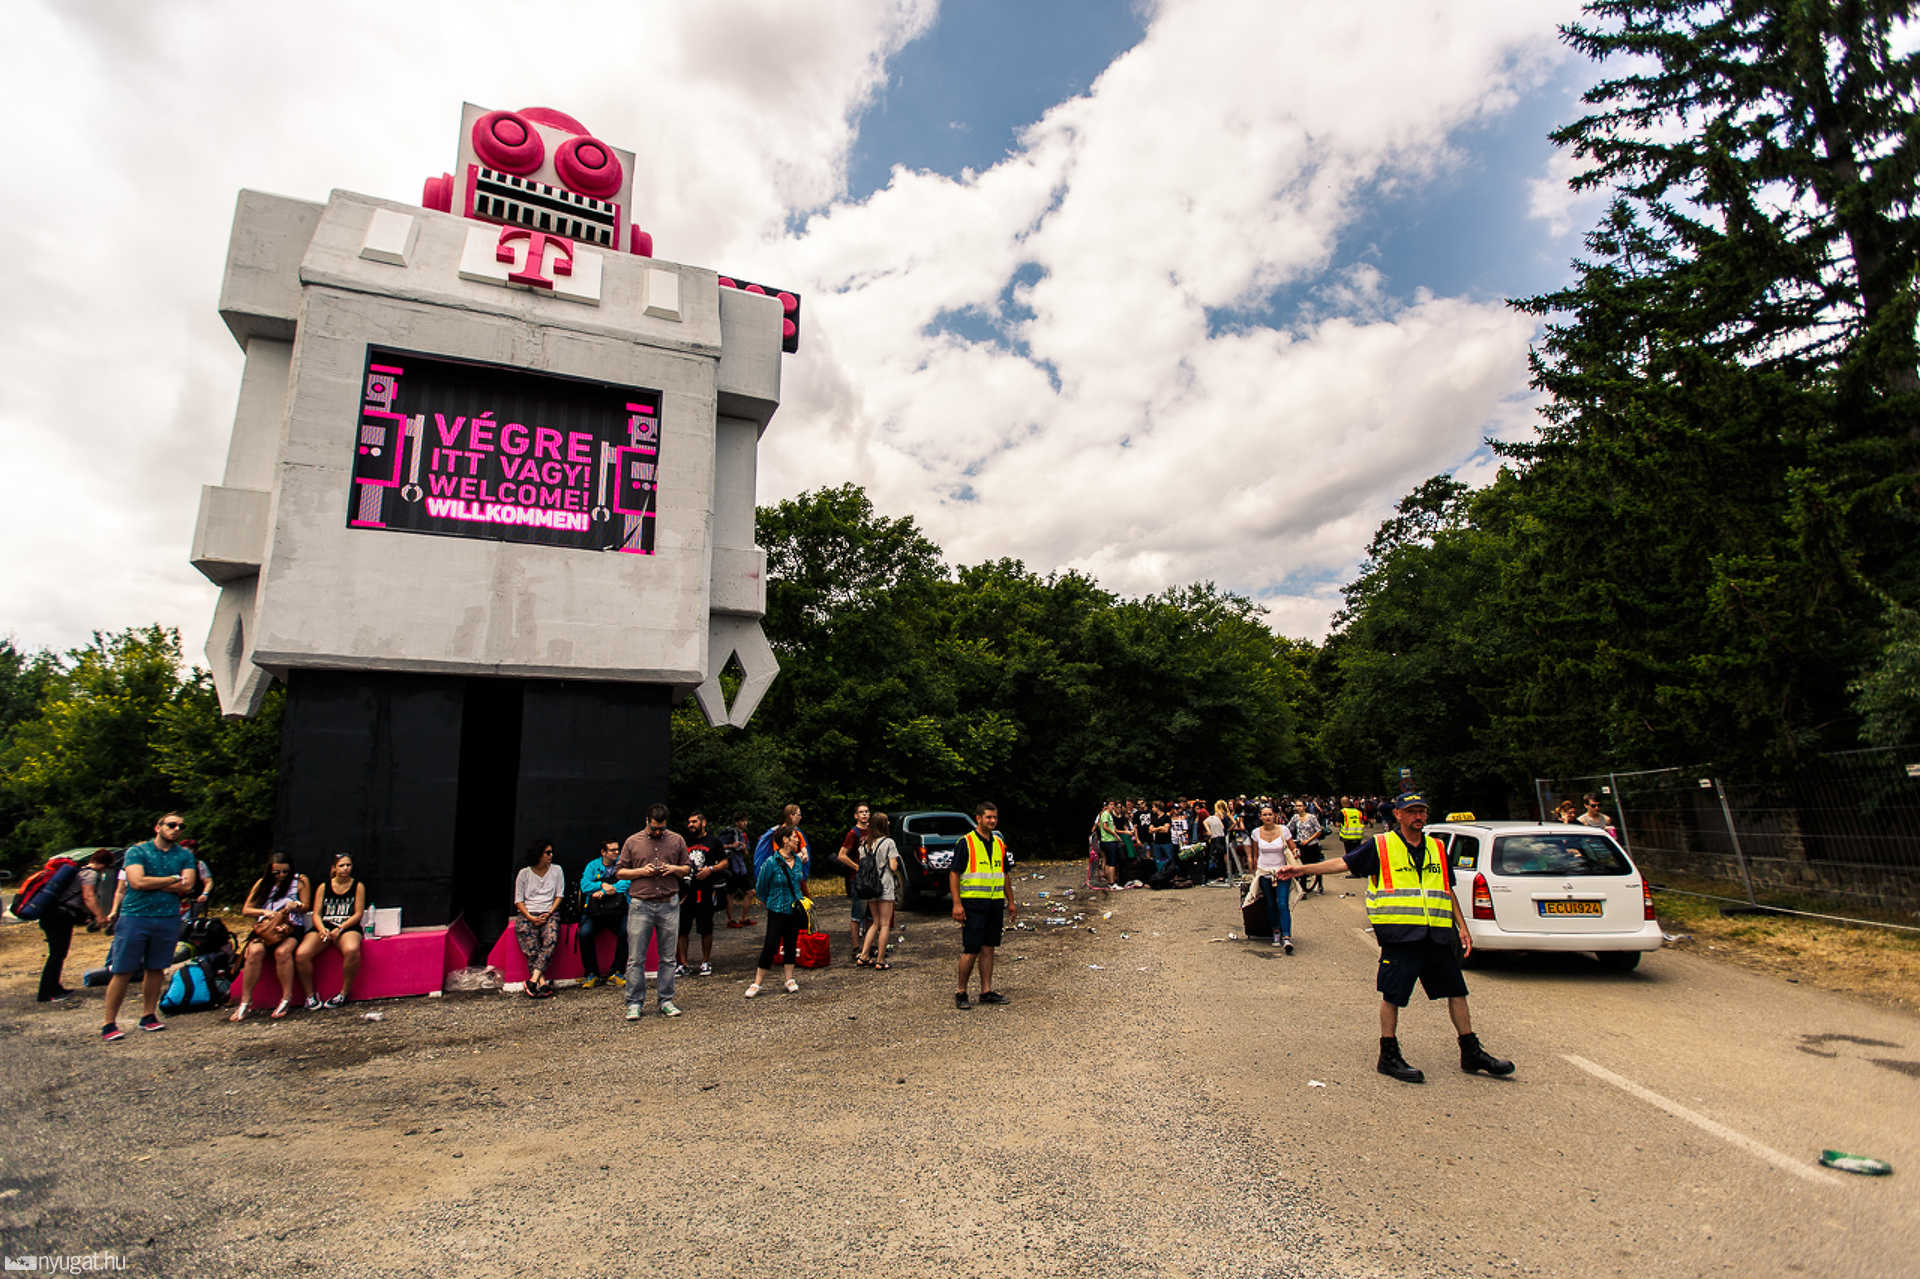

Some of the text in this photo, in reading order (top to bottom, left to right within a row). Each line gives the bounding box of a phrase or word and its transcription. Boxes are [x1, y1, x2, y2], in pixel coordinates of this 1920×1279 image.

[496, 224, 574, 290] T
[434, 412, 593, 464] VÉGRE
[432, 448, 591, 488] ITT VAGY!
[428, 474, 590, 510] WELCOME!
